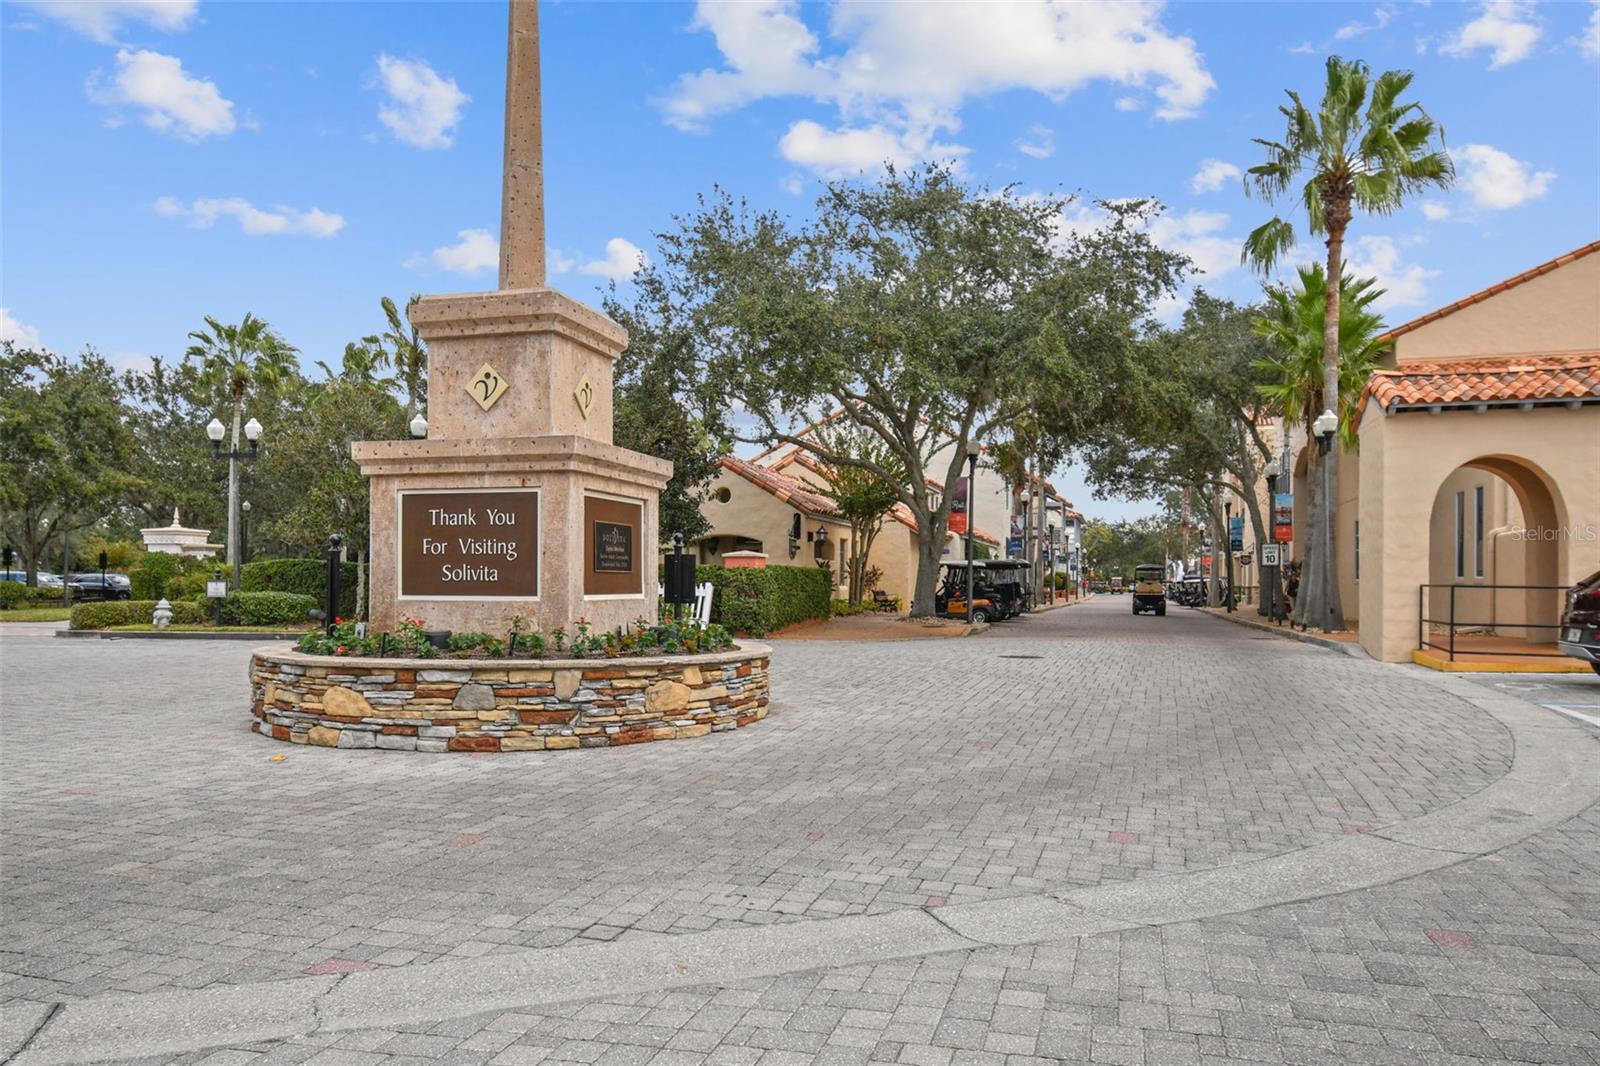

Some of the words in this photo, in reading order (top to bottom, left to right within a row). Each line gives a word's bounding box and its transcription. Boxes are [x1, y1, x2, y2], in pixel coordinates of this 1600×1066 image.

[428, 508, 476, 526] Thank
[486, 508, 515, 526] You
[422, 538, 448, 555] For
[458, 538, 518, 561] Visiting
[1265, 555, 1276, 563] 10
[441, 563, 498, 582] Solivita
